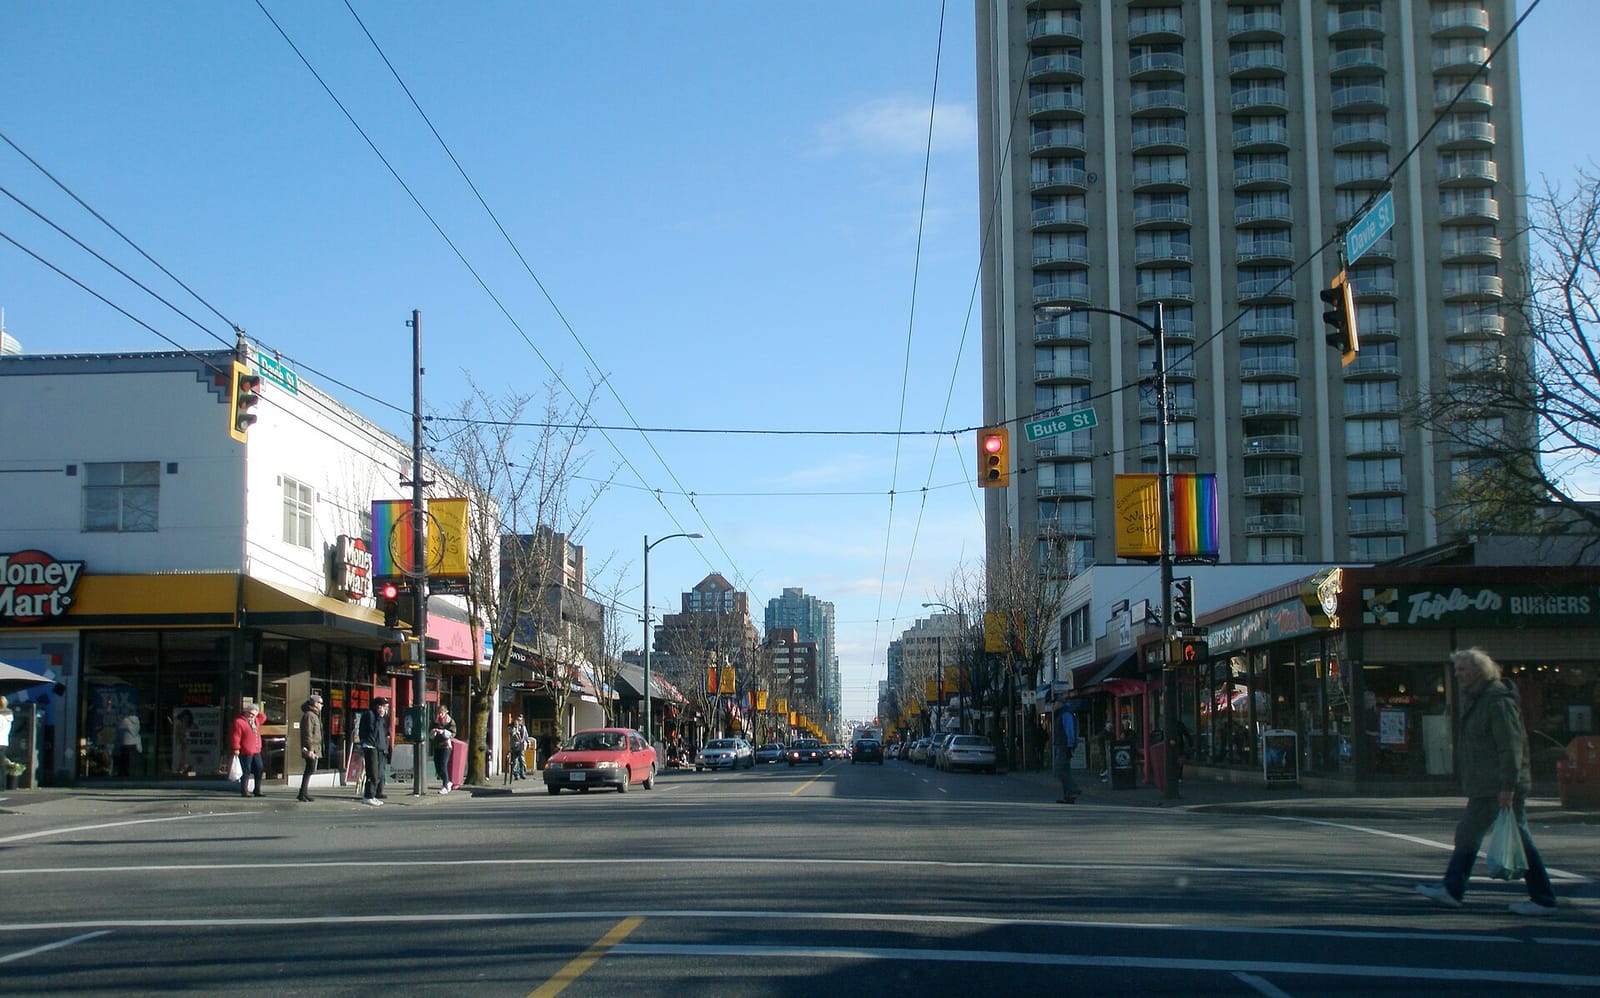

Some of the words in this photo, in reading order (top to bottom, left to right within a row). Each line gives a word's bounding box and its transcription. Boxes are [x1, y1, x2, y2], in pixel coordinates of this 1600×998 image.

[1350, 221, 1376, 255] Davie
[1378, 203, 1390, 229] St
[1032, 421, 1067, 437] Bute
[1072, 413, 1090, 428] St
[344, 537, 373, 574] Money
[344, 565, 372, 598] Mart
[1510, 596, 1591, 615] BURGERS
